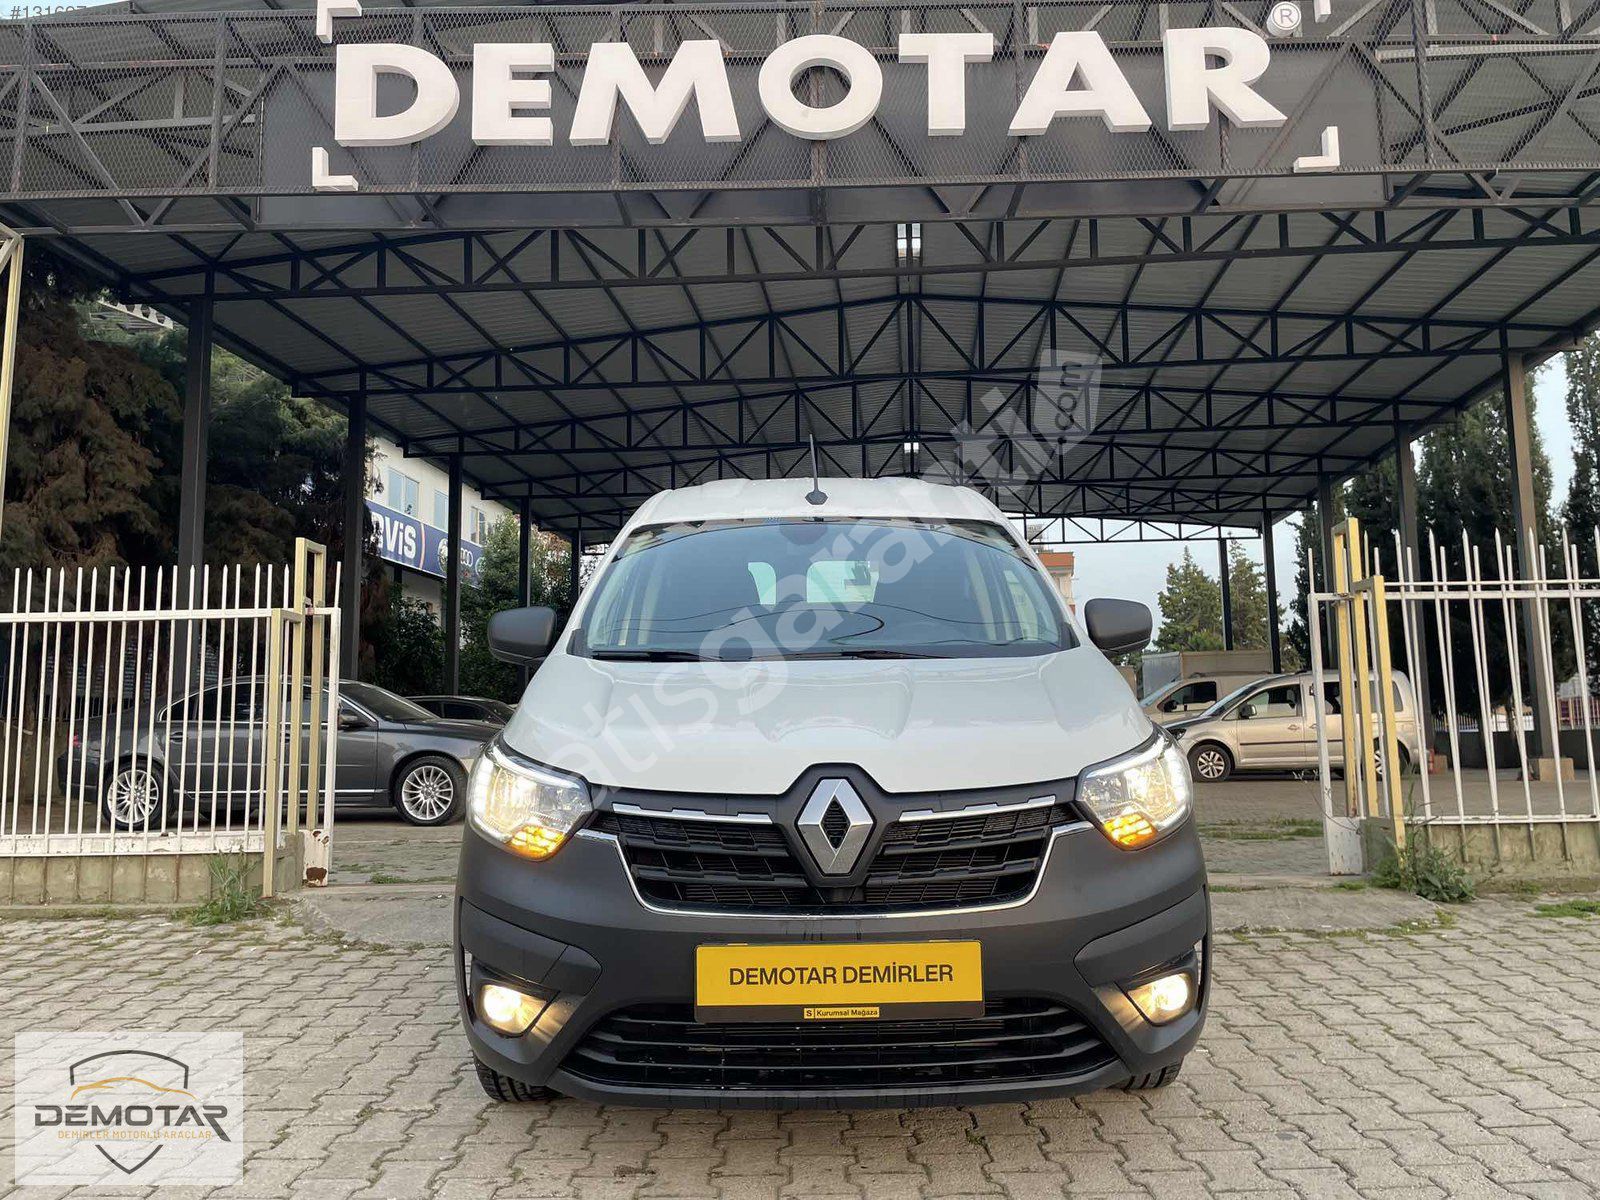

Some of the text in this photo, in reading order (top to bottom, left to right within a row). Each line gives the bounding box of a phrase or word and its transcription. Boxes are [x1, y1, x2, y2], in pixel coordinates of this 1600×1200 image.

[334, 27, 1287, 148] DEMOTAR
[729, 962, 953, 985] DEMOTAR DEMİRLER
[816, 1009, 850, 1017] Kurumsal
